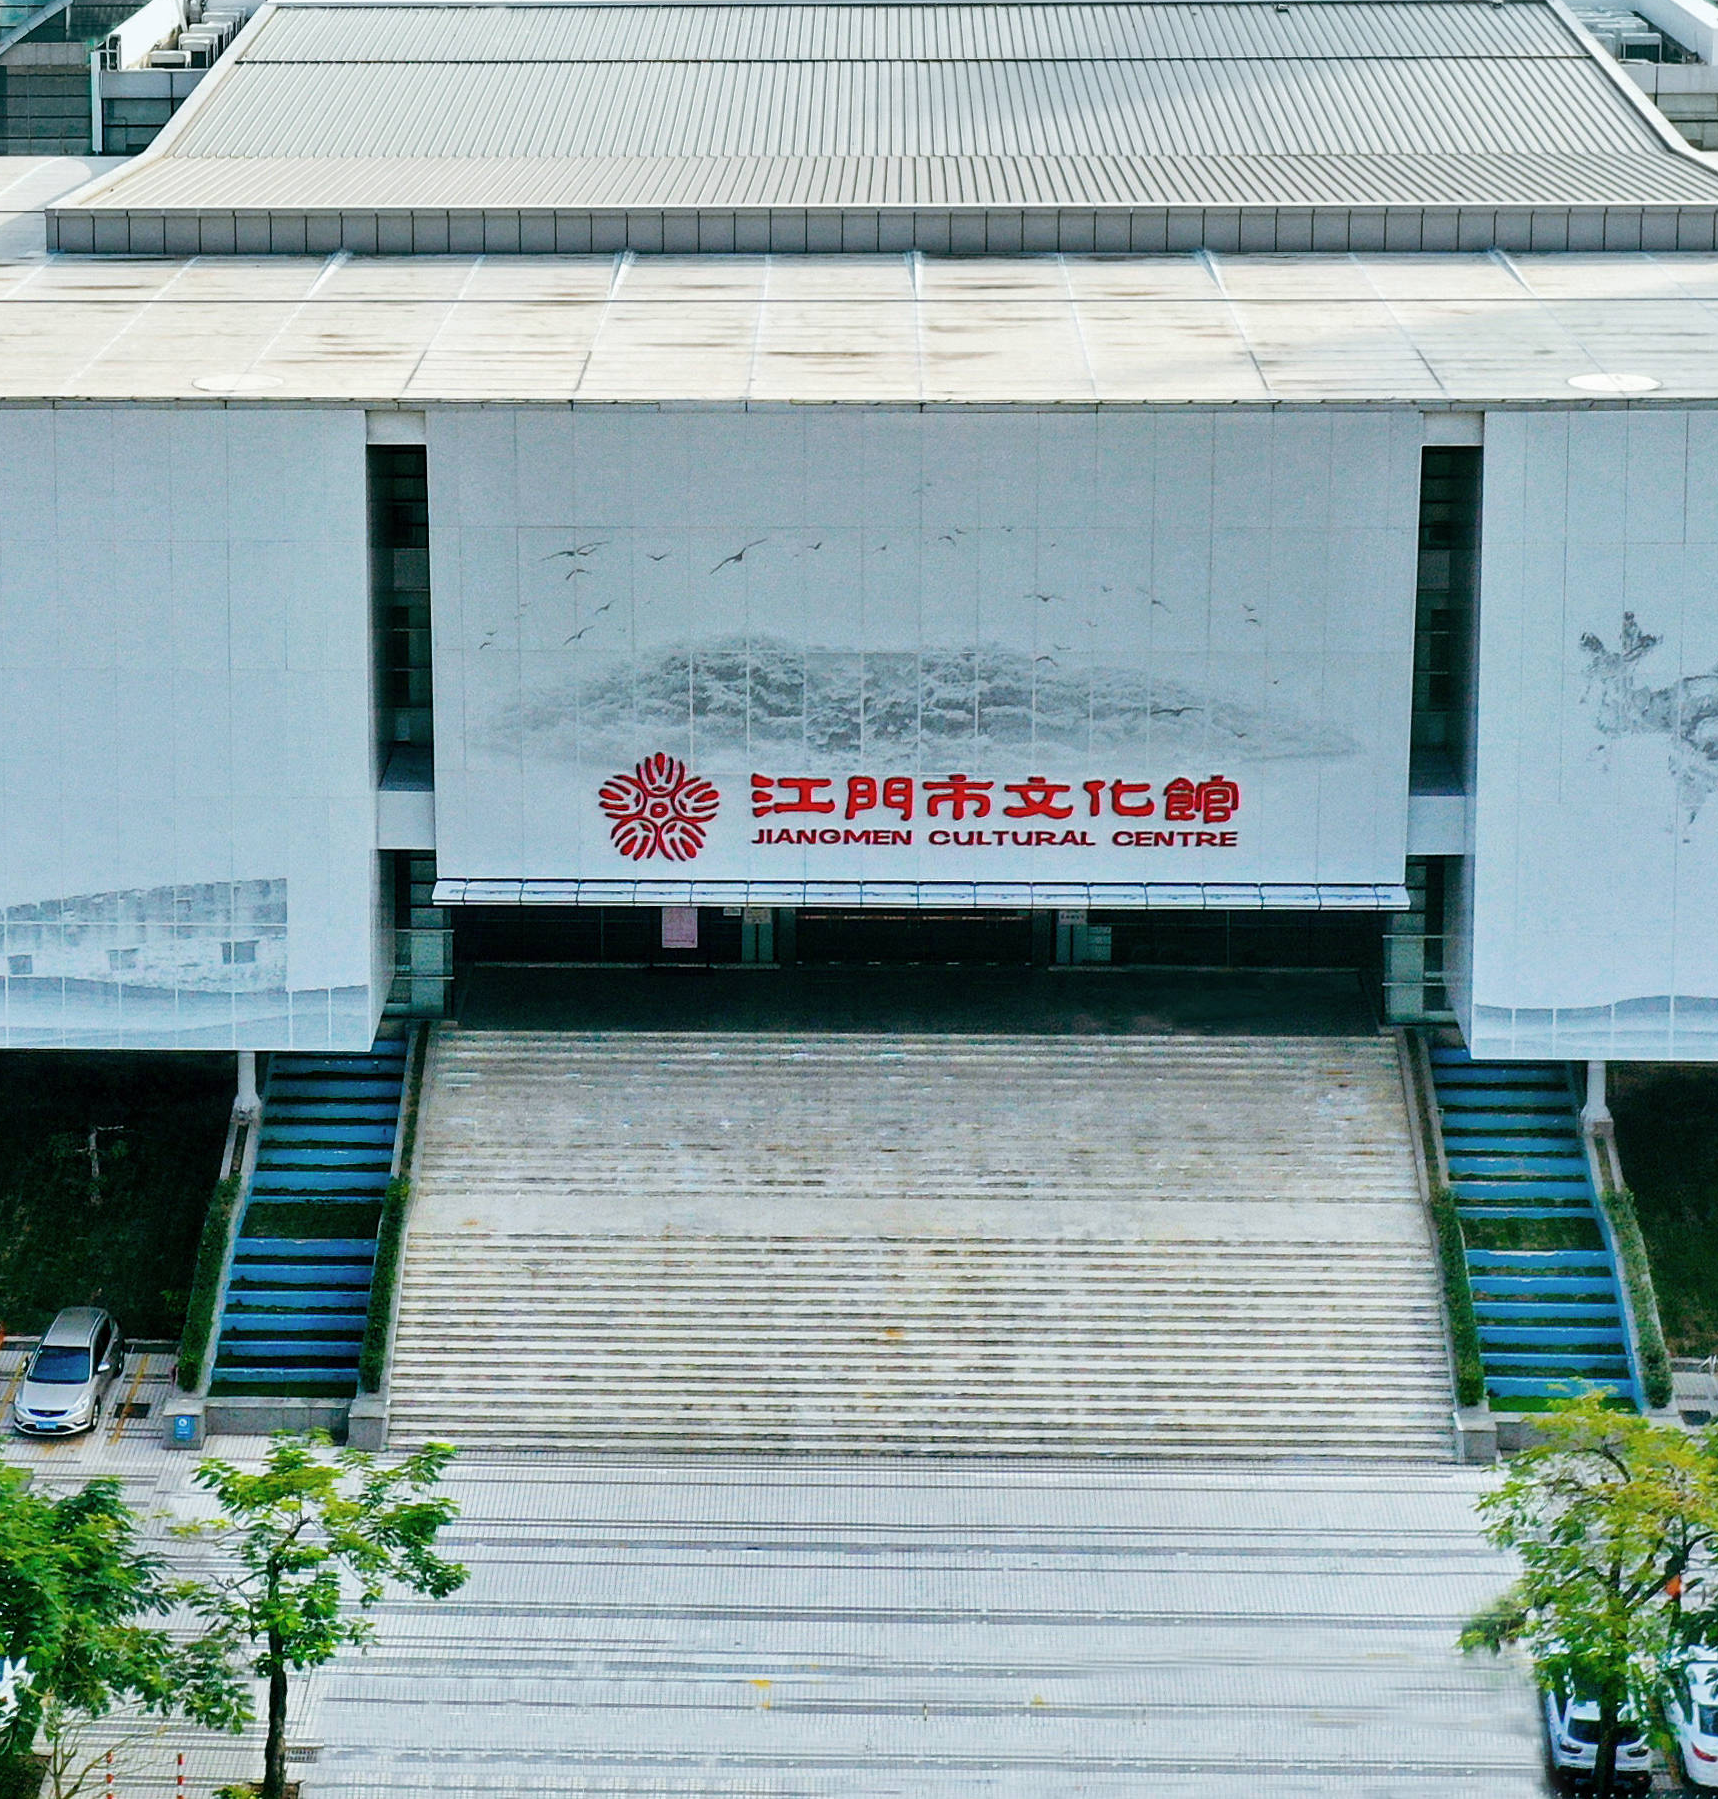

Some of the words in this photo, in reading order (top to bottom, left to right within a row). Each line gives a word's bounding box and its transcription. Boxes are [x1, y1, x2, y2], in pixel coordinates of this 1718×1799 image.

[750, 773, 1241, 823] 江門市文化館
[751, 829, 913, 846] JIANGMEN
[928, 830, 1097, 846] CULTURAL
[1112, 831, 1239, 847] CENTRE
